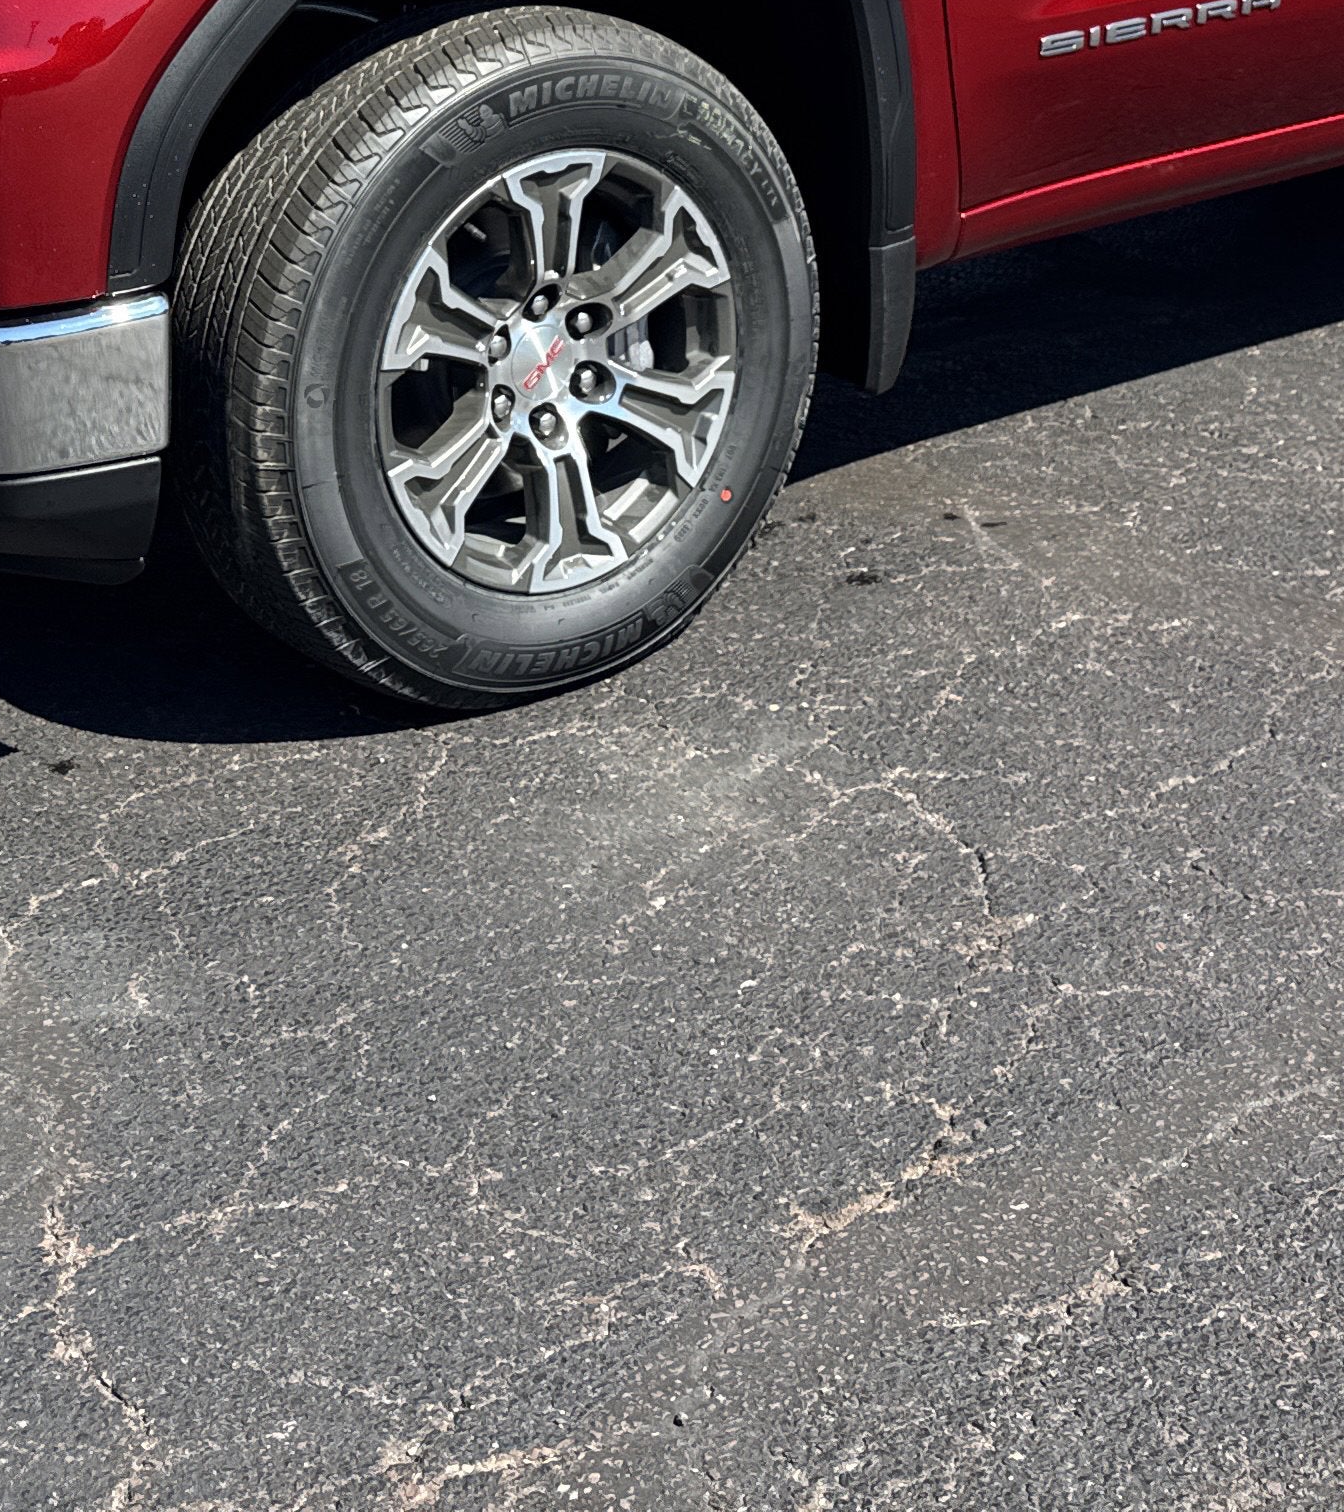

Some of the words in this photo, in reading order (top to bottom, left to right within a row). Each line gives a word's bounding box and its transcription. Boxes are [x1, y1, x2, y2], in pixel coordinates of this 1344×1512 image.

[508, 74, 673, 118] MICHELIN
[523, 334, 565, 391] GMC
[467, 617, 644, 675] MICHELIN
